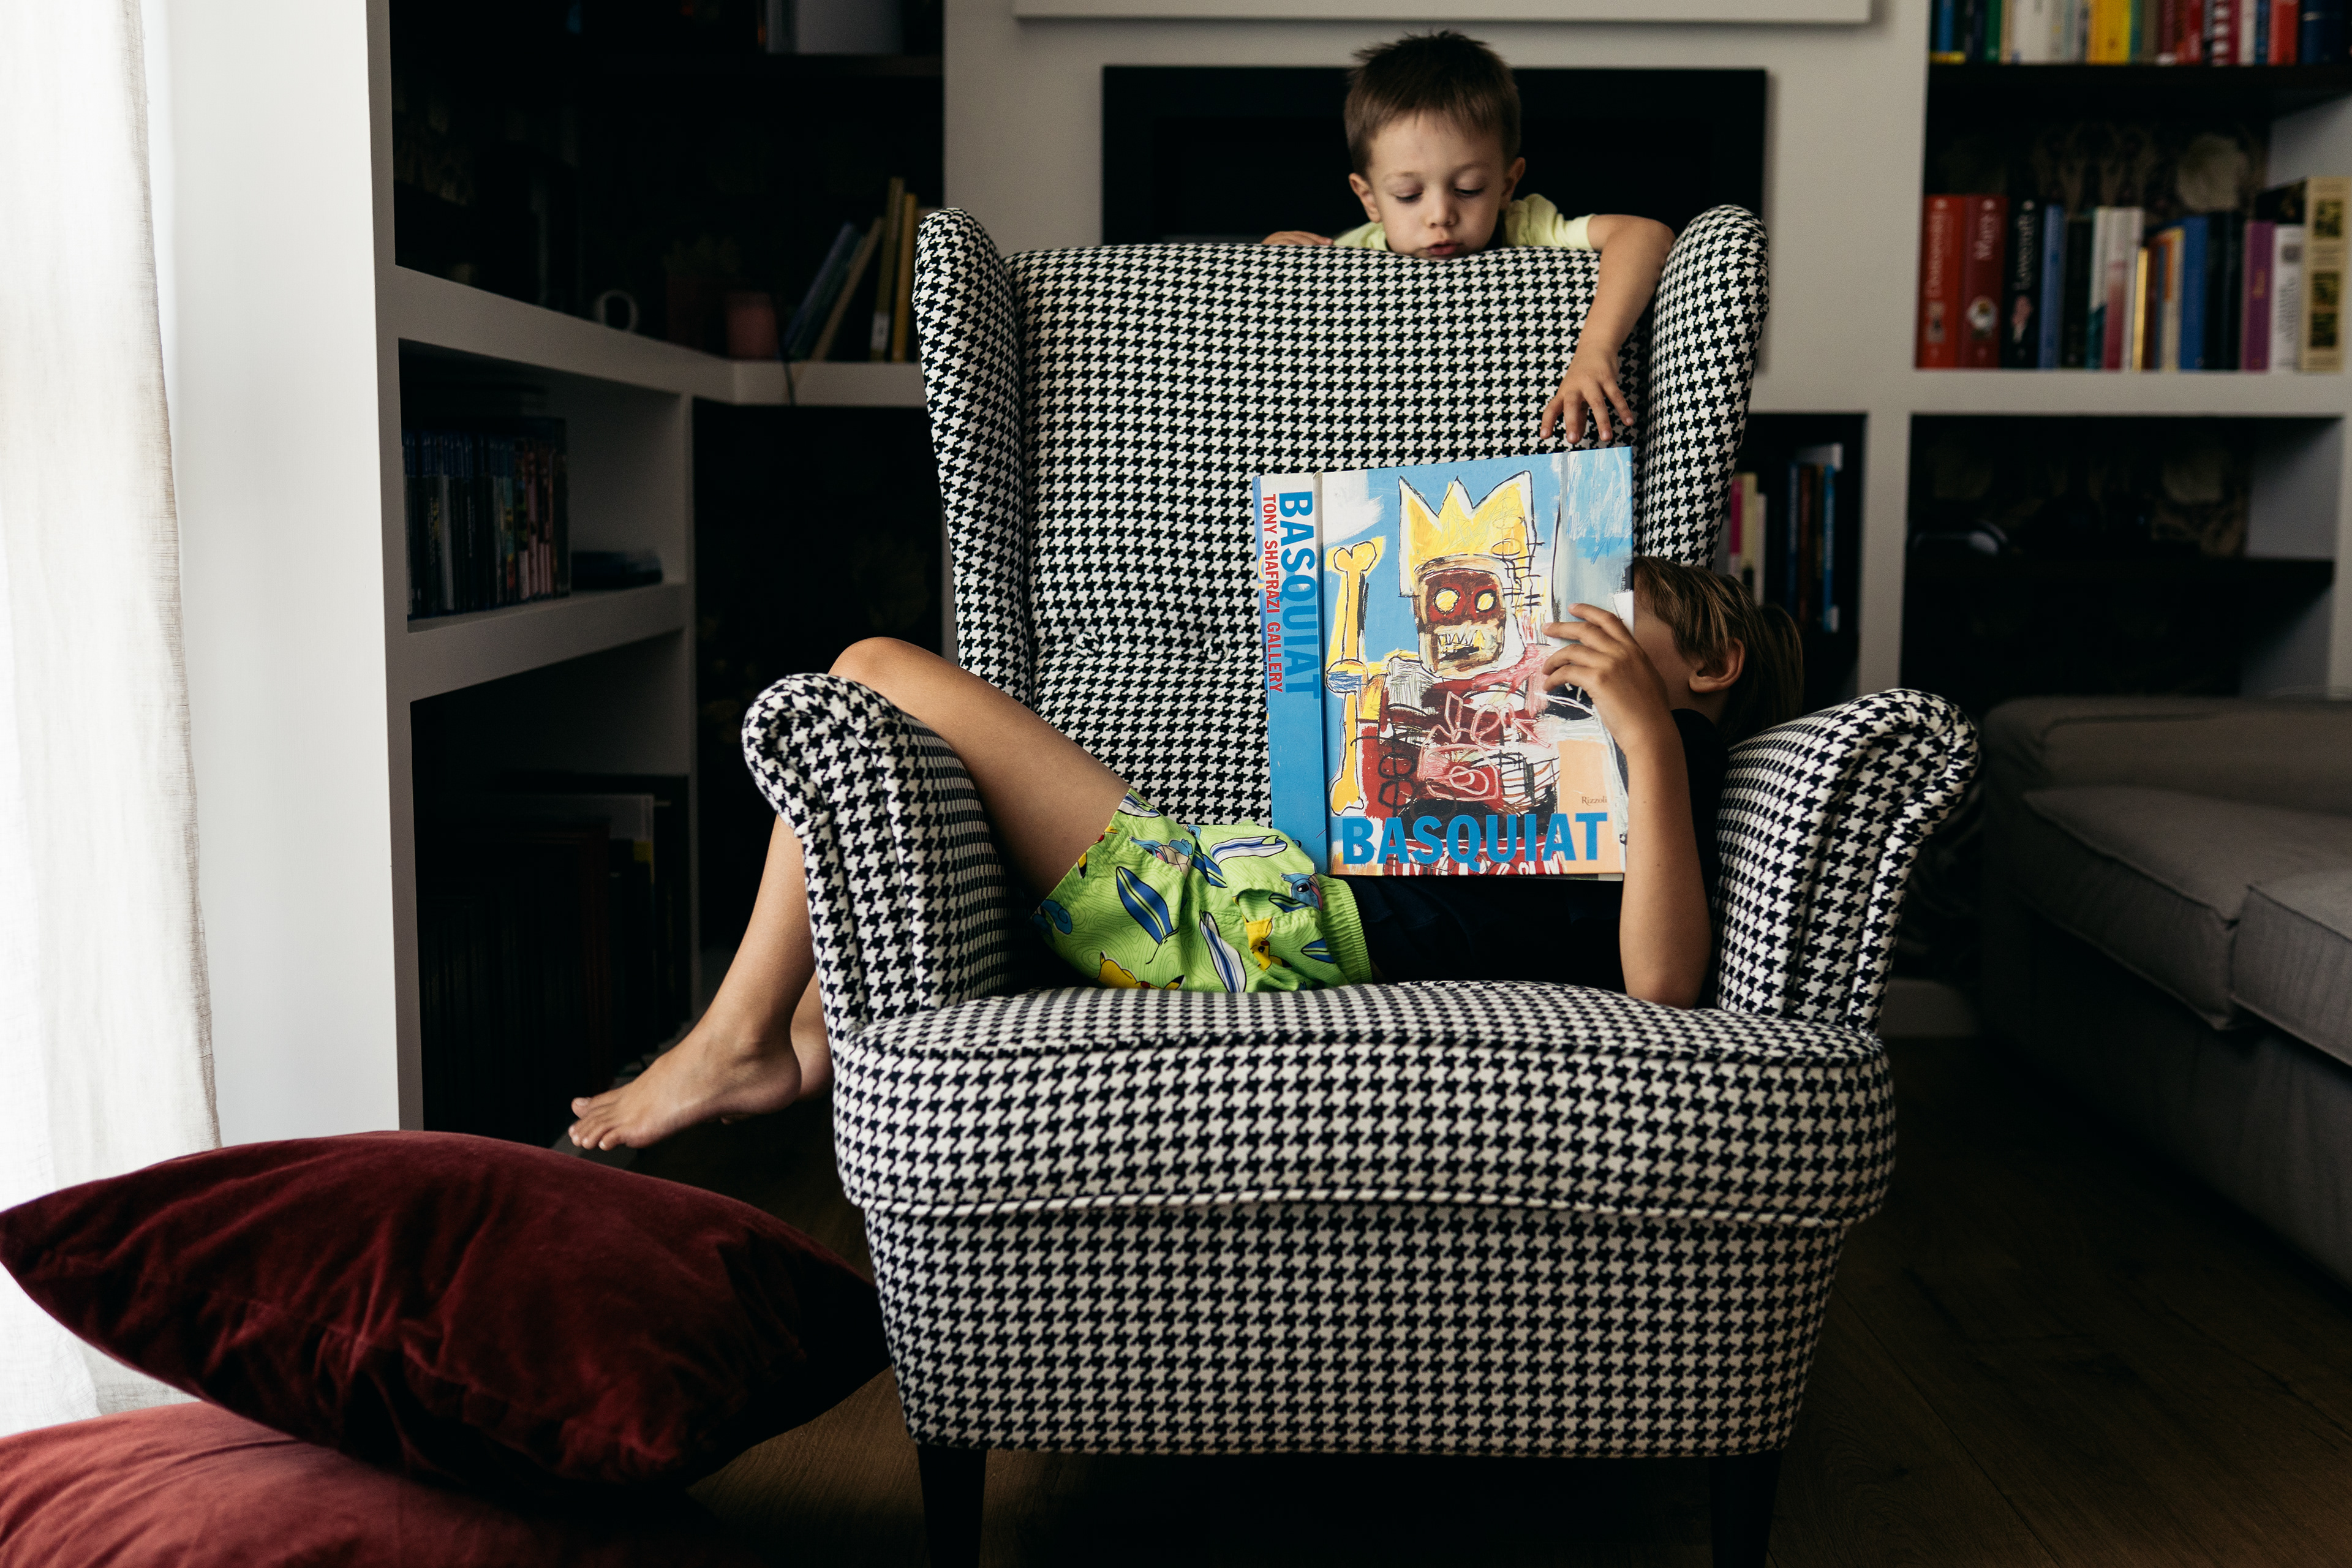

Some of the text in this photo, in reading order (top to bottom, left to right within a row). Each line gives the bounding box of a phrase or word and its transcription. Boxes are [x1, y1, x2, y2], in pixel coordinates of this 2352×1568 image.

[1263, 494, 1283, 693] TONY SHAFRAZI GALLERY
[1279, 491, 1321, 699] BASQUIAT
[1342, 812, 1608, 872] BASQUIAT
[1581, 796, 1607, 806] Rizzoli
